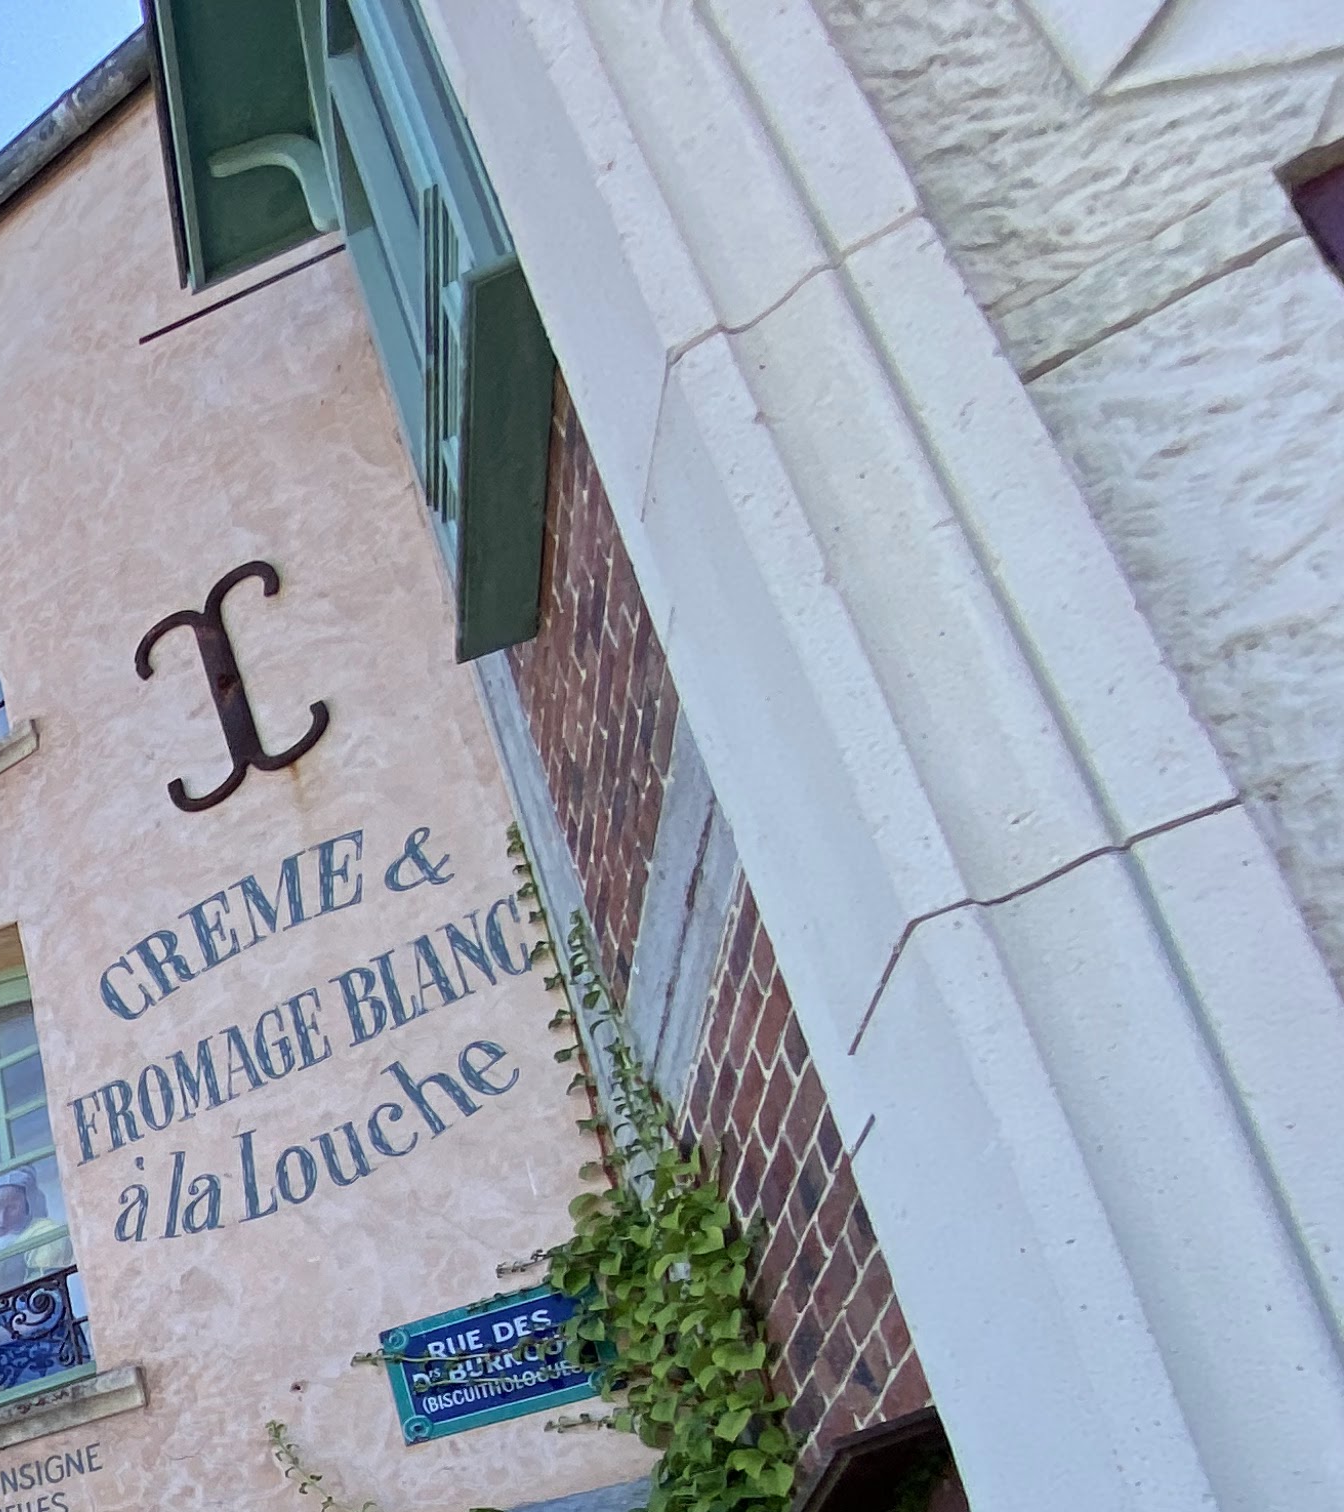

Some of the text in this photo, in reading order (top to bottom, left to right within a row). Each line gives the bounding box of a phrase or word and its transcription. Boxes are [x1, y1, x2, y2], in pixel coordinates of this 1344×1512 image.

[99, 827, 455, 1020] CREME &
[69, 893, 533, 1167] FROMAGE BLANC
[113, 1039, 520, 1242] à la Louche
[427, 1309, 552, 1358] RUE DES
